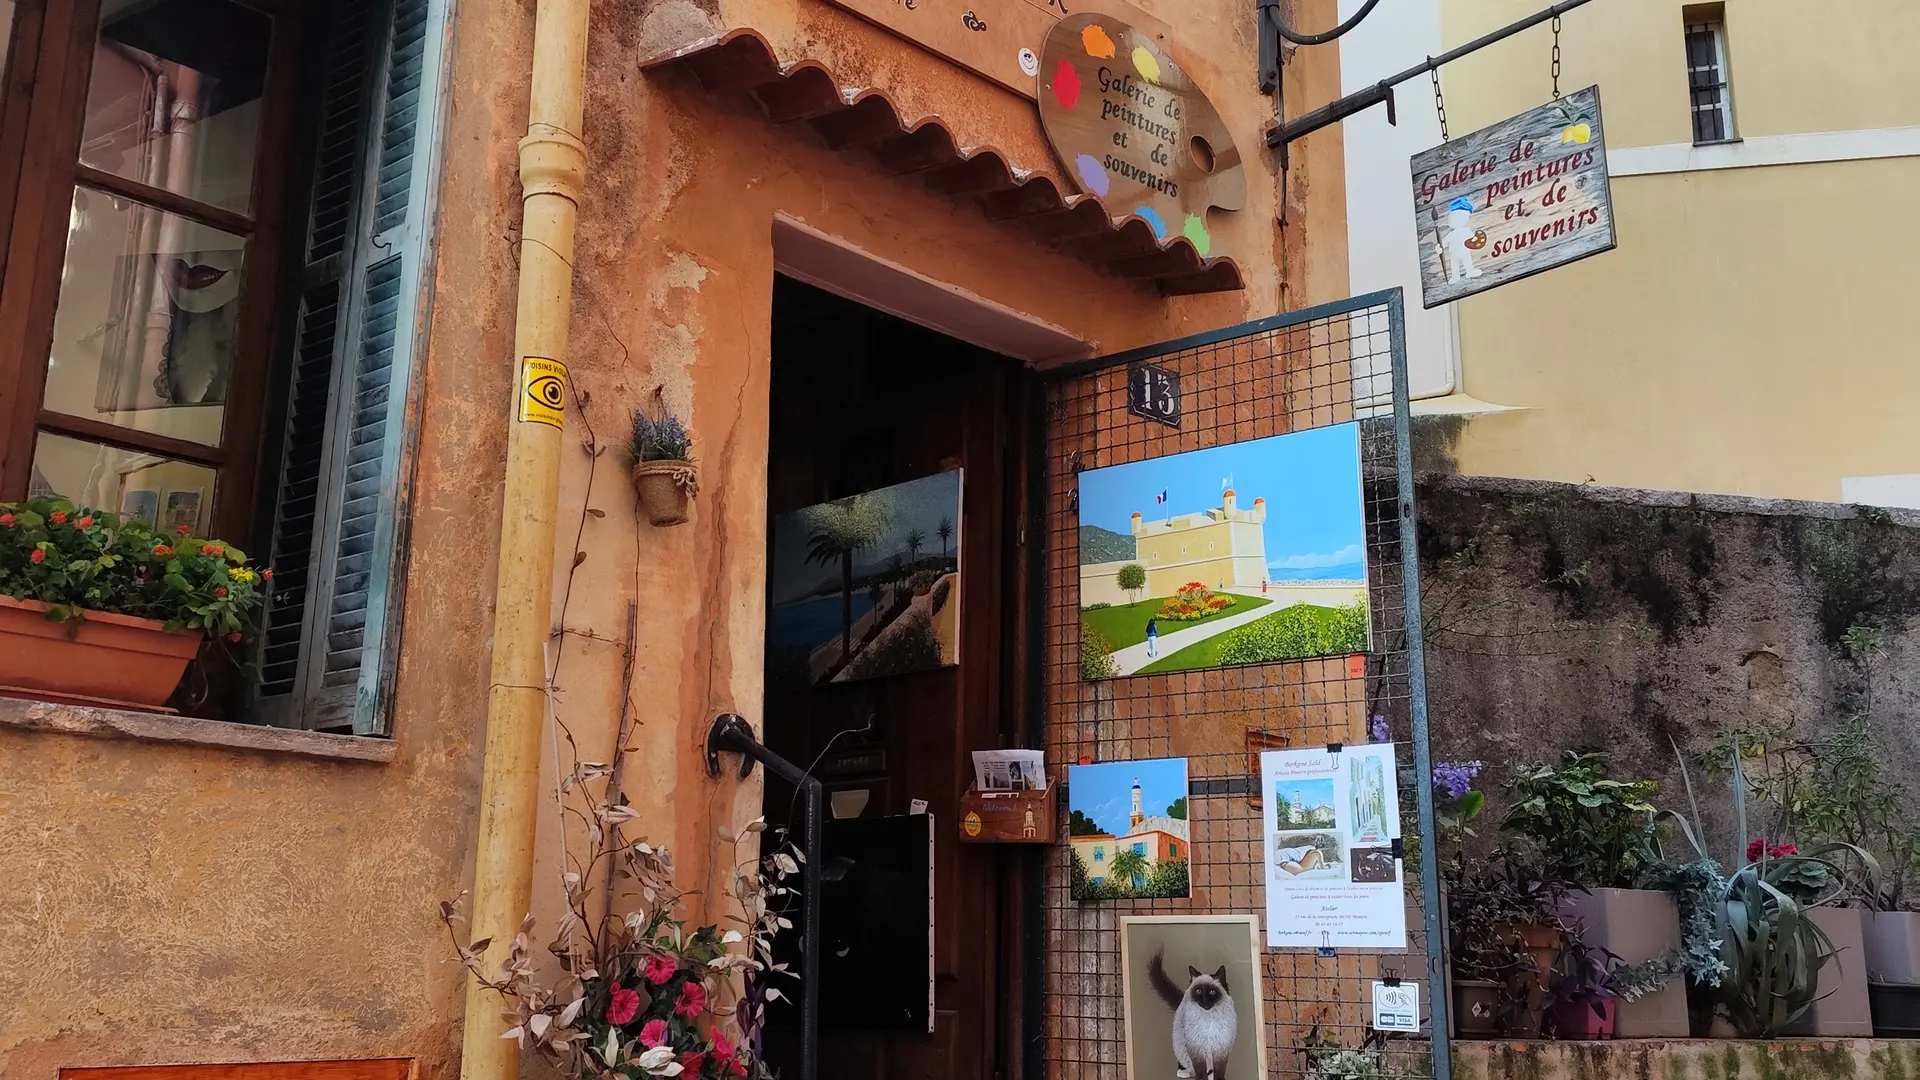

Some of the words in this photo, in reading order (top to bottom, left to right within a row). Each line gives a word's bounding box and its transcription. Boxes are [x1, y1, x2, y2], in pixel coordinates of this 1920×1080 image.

[1098, 66, 1155, 108] Galerie
[1164, 98, 1181, 121] de
[1101, 98, 1176, 145] peintures
[1113, 131, 1128, 148] et
[1150, 144, 1168, 167] de
[1421, 152, 1498, 205] Galerie
[1508, 134, 1535, 164] de
[1103, 154, 1178, 198] souvenirs
[1485, 147, 1595, 208] peintures
[1504, 198, 1526, 221] et
[1541, 178, 1567, 208] de
[1491, 206, 1599, 258] souvenirs
[1140, 367, 1175, 415] 13
